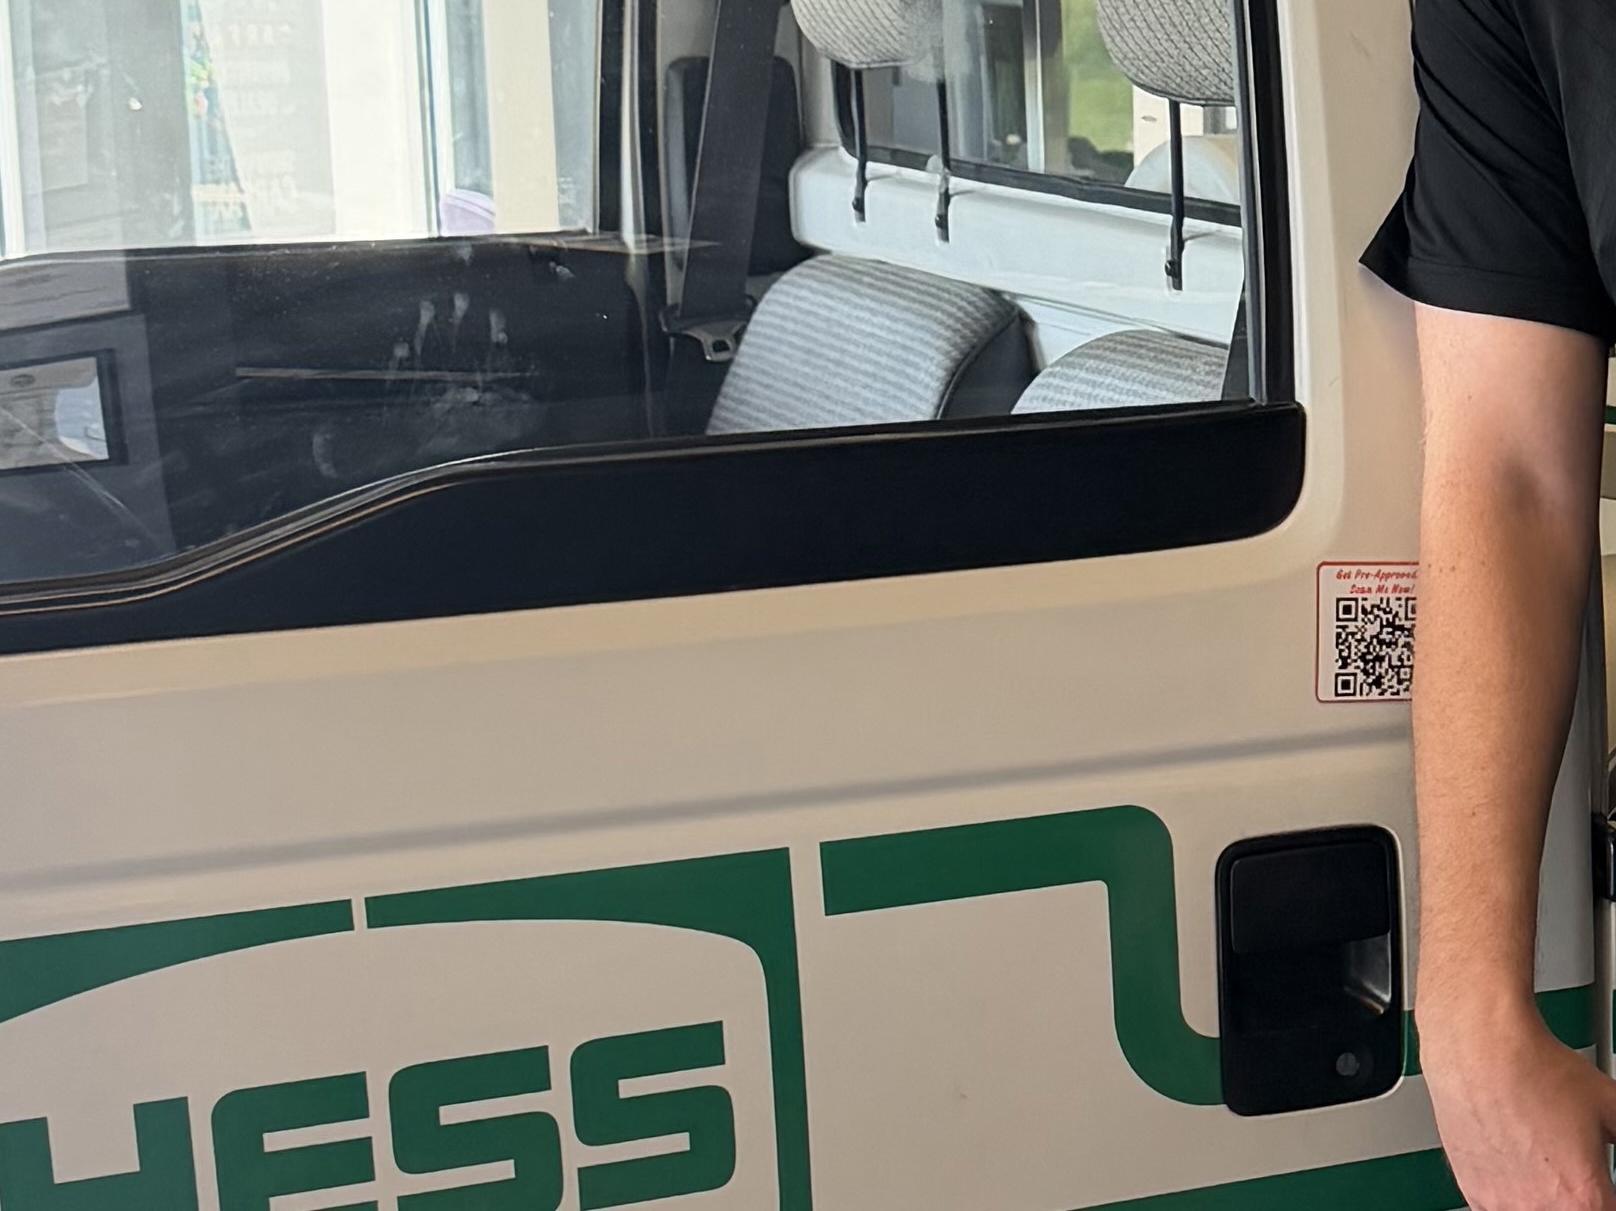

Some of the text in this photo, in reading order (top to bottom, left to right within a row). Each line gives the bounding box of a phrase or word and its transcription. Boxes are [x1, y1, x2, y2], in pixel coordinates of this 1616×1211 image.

[1335, 568, 1351, 580] Get
[1350, 583, 1373, 594] Scan
[1375, 584, 1389, 594] Me
